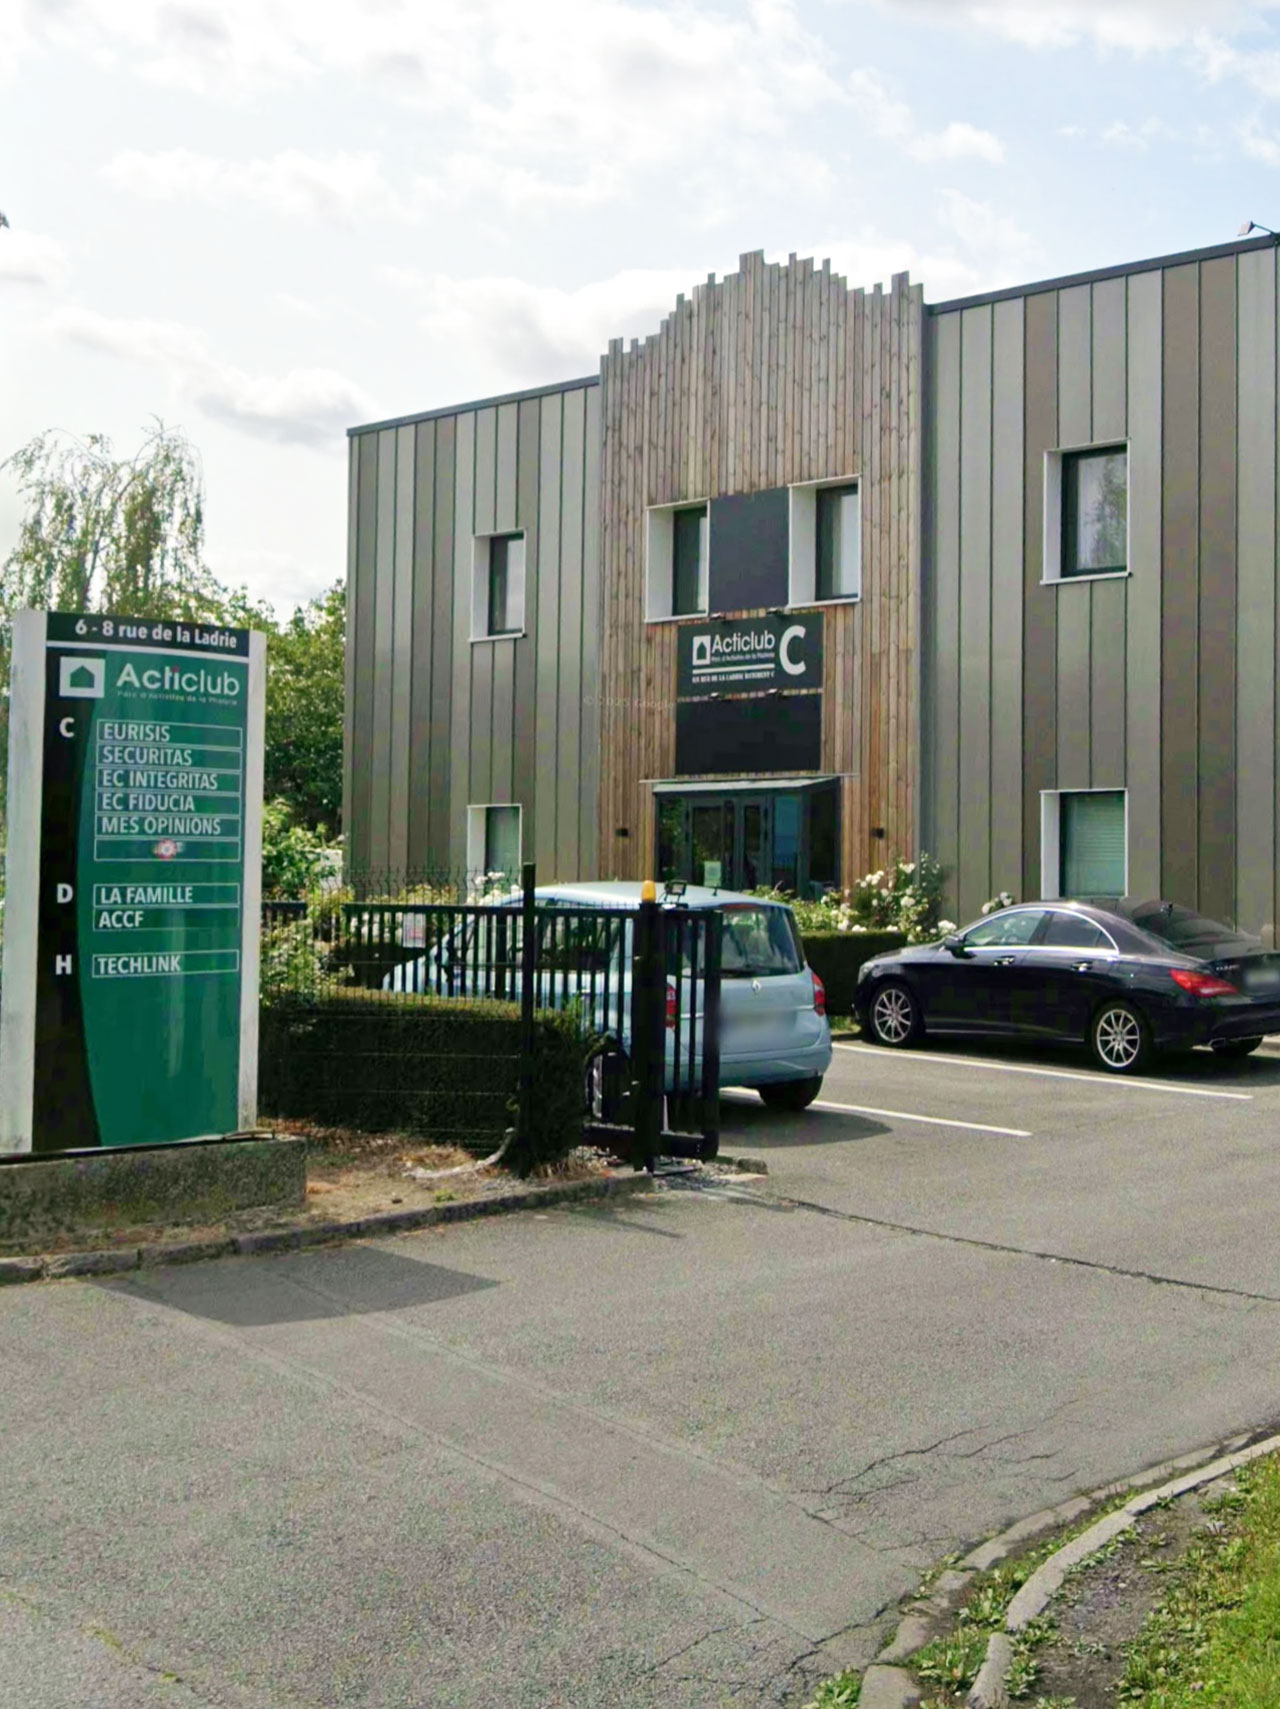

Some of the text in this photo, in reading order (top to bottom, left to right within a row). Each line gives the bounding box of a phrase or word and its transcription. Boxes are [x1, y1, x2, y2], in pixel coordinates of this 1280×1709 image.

[75, 619, 87, 635] 6
[102, 620, 114, 637] 8
[118, 624, 148, 639] rue
[152, 624, 172, 642] de
[176, 626, 190, 643] la
[195, 627, 237, 648] Ladrie
[712, 630, 775, 654] Acticlub
[779, 625, 806, 676] C
[116, 663, 240, 696] Acticlub
[59, 717, 75, 738] C
[103, 723, 170, 742] EURISIS
[103, 747, 192, 766] SECURITAS
[103, 770, 218, 790] EC INTEGRITAS
[102, 793, 195, 812] EC FIDUCIA
[101, 817, 221, 835] MES OPINIONS
[57, 883, 73, 904] D
[101, 886, 193, 904] LA FAMILLE
[98, 911, 144, 928] ACCF
[55, 955, 72, 975] H
[97, 955, 181, 974] TECHLINK
